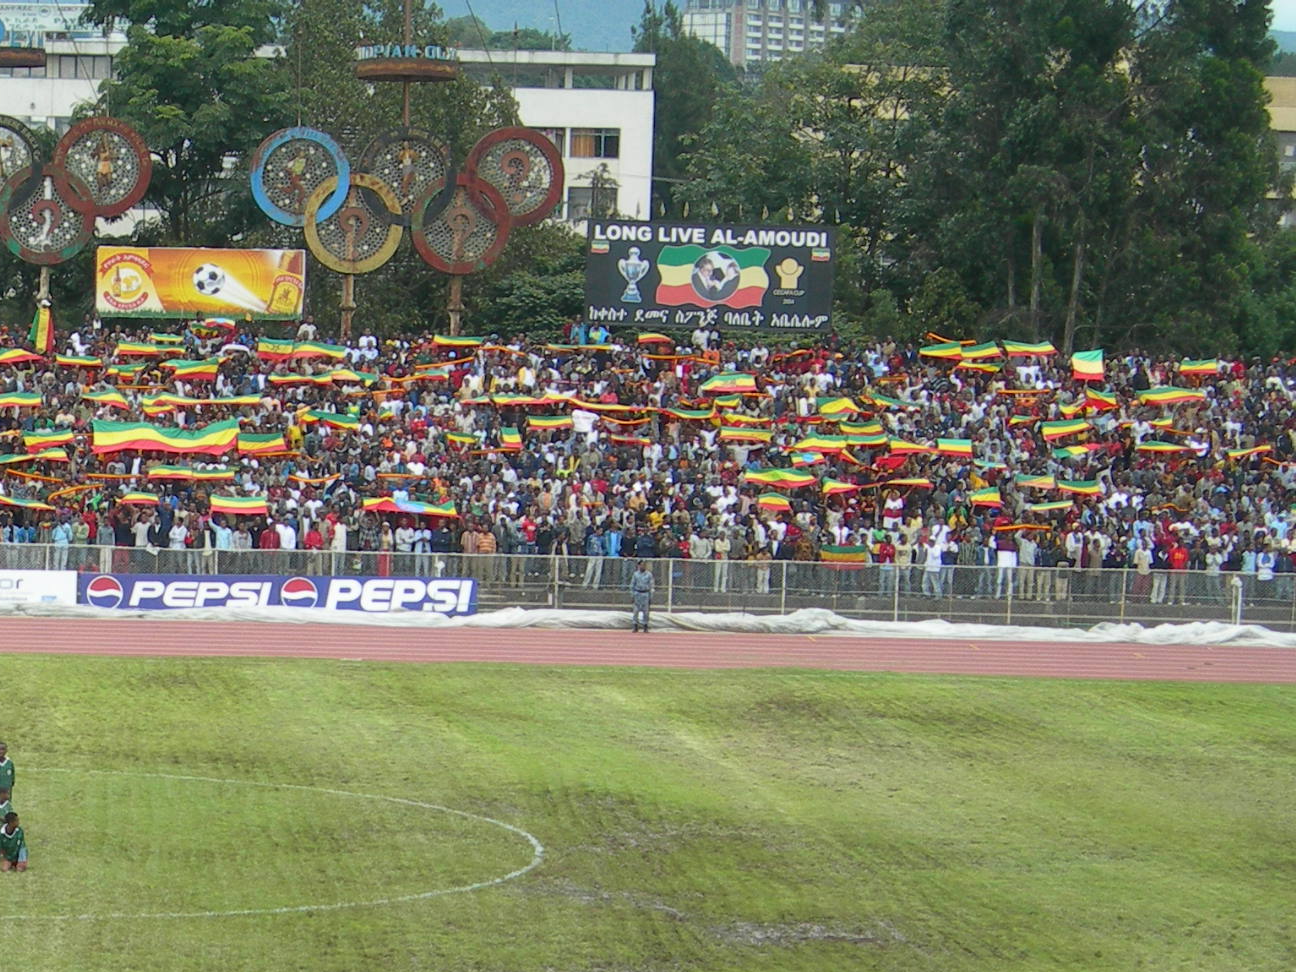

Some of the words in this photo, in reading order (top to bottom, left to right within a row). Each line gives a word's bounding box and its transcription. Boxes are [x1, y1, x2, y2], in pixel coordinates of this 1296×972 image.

[594, 225, 652, 242] LONG
[658, 227, 705, 243] LIVE
[711, 229, 828, 247] AL-AMOUDI
[128, 581, 272, 608] PEPSI
[326, 579, 473, 613] PEPSI
